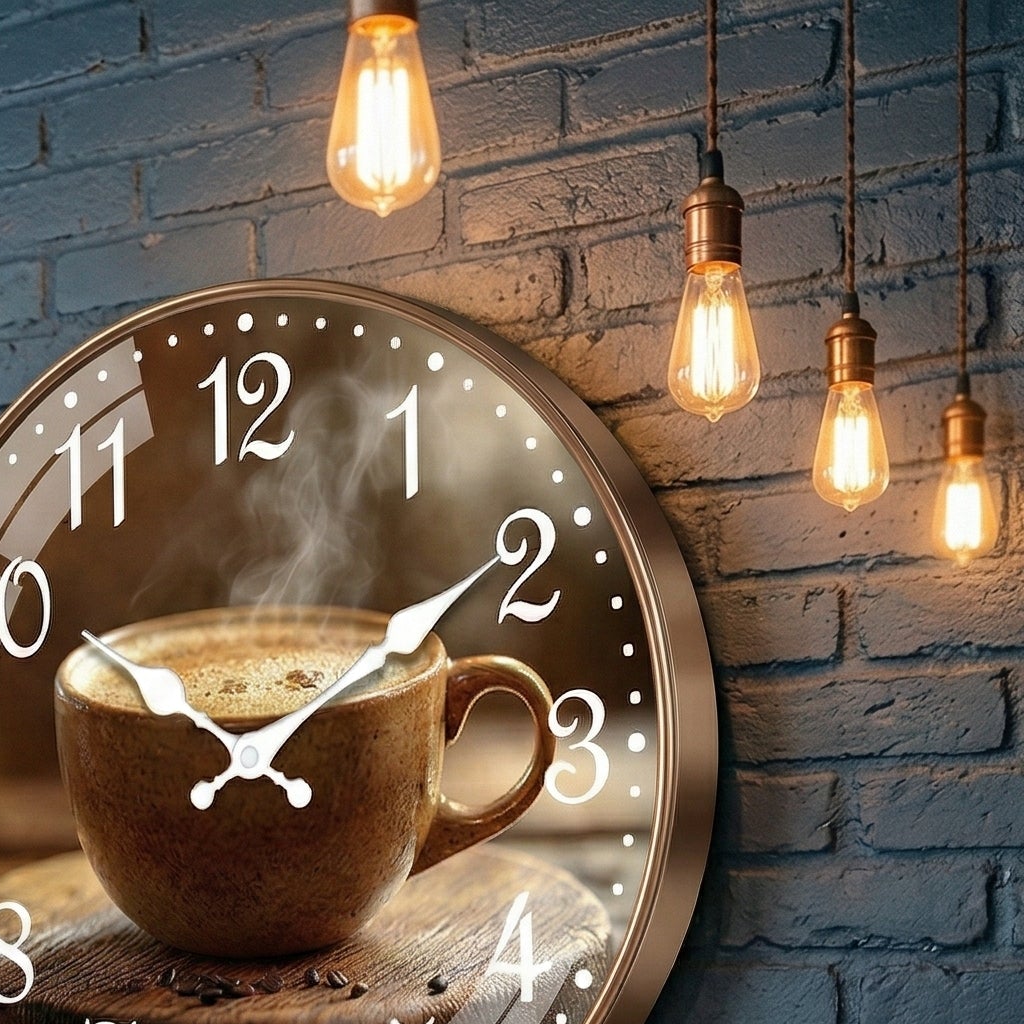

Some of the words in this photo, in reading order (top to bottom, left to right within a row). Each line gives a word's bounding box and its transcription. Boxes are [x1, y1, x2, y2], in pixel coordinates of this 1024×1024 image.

[197, 351, 296, 466] 12
[385, 384, 420, 500] 1
[54, 417, 126, 531] 11
[495, 507, 562, 625] 2
[543, 688, 611, 806] 3
[484, 890, 553, 1003] 4
